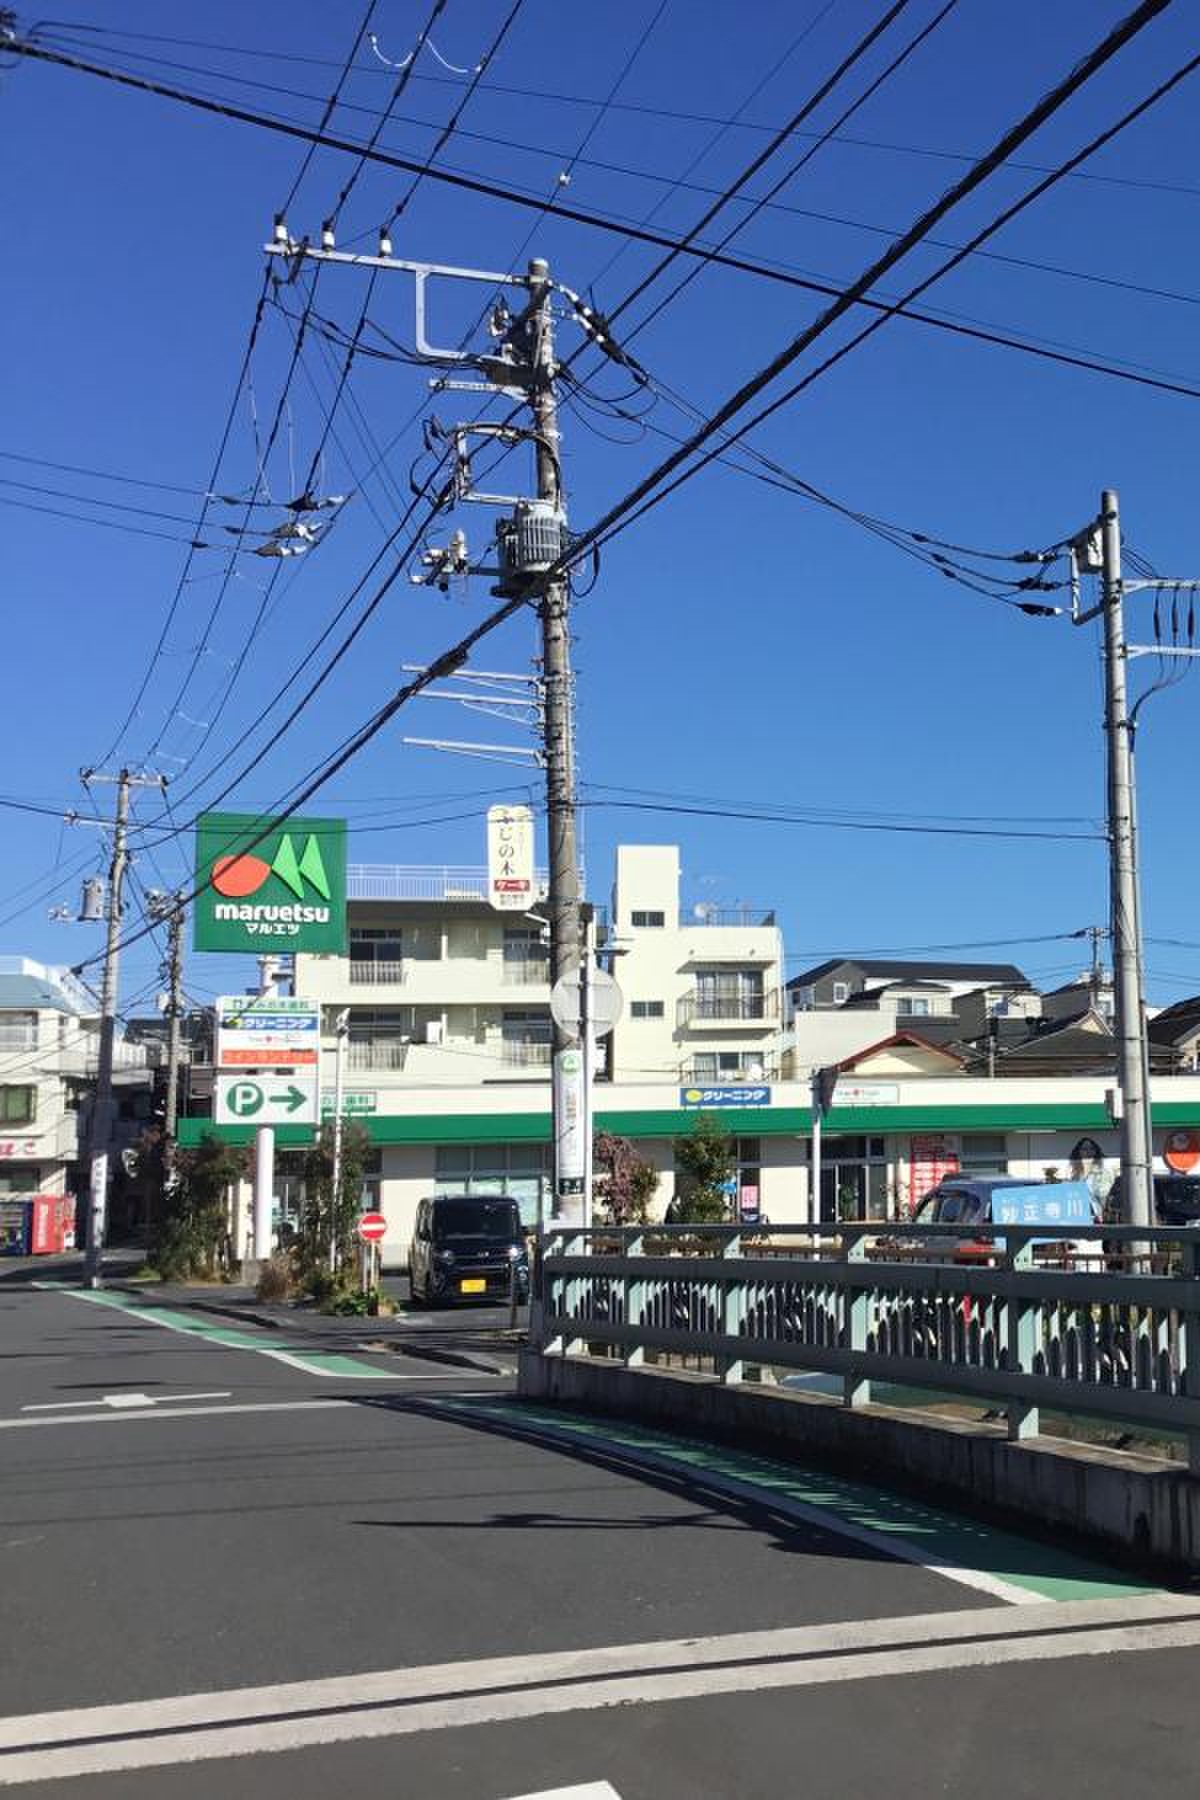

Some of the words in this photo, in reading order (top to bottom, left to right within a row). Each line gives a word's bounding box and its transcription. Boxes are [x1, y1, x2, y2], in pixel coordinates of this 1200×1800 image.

[215, 903, 329, 922] maruetsu
[245, 922, 300, 935] マルエツ
[234, 1085, 259, 1113] P
[703, 1089, 766, 1101] クリーニング
